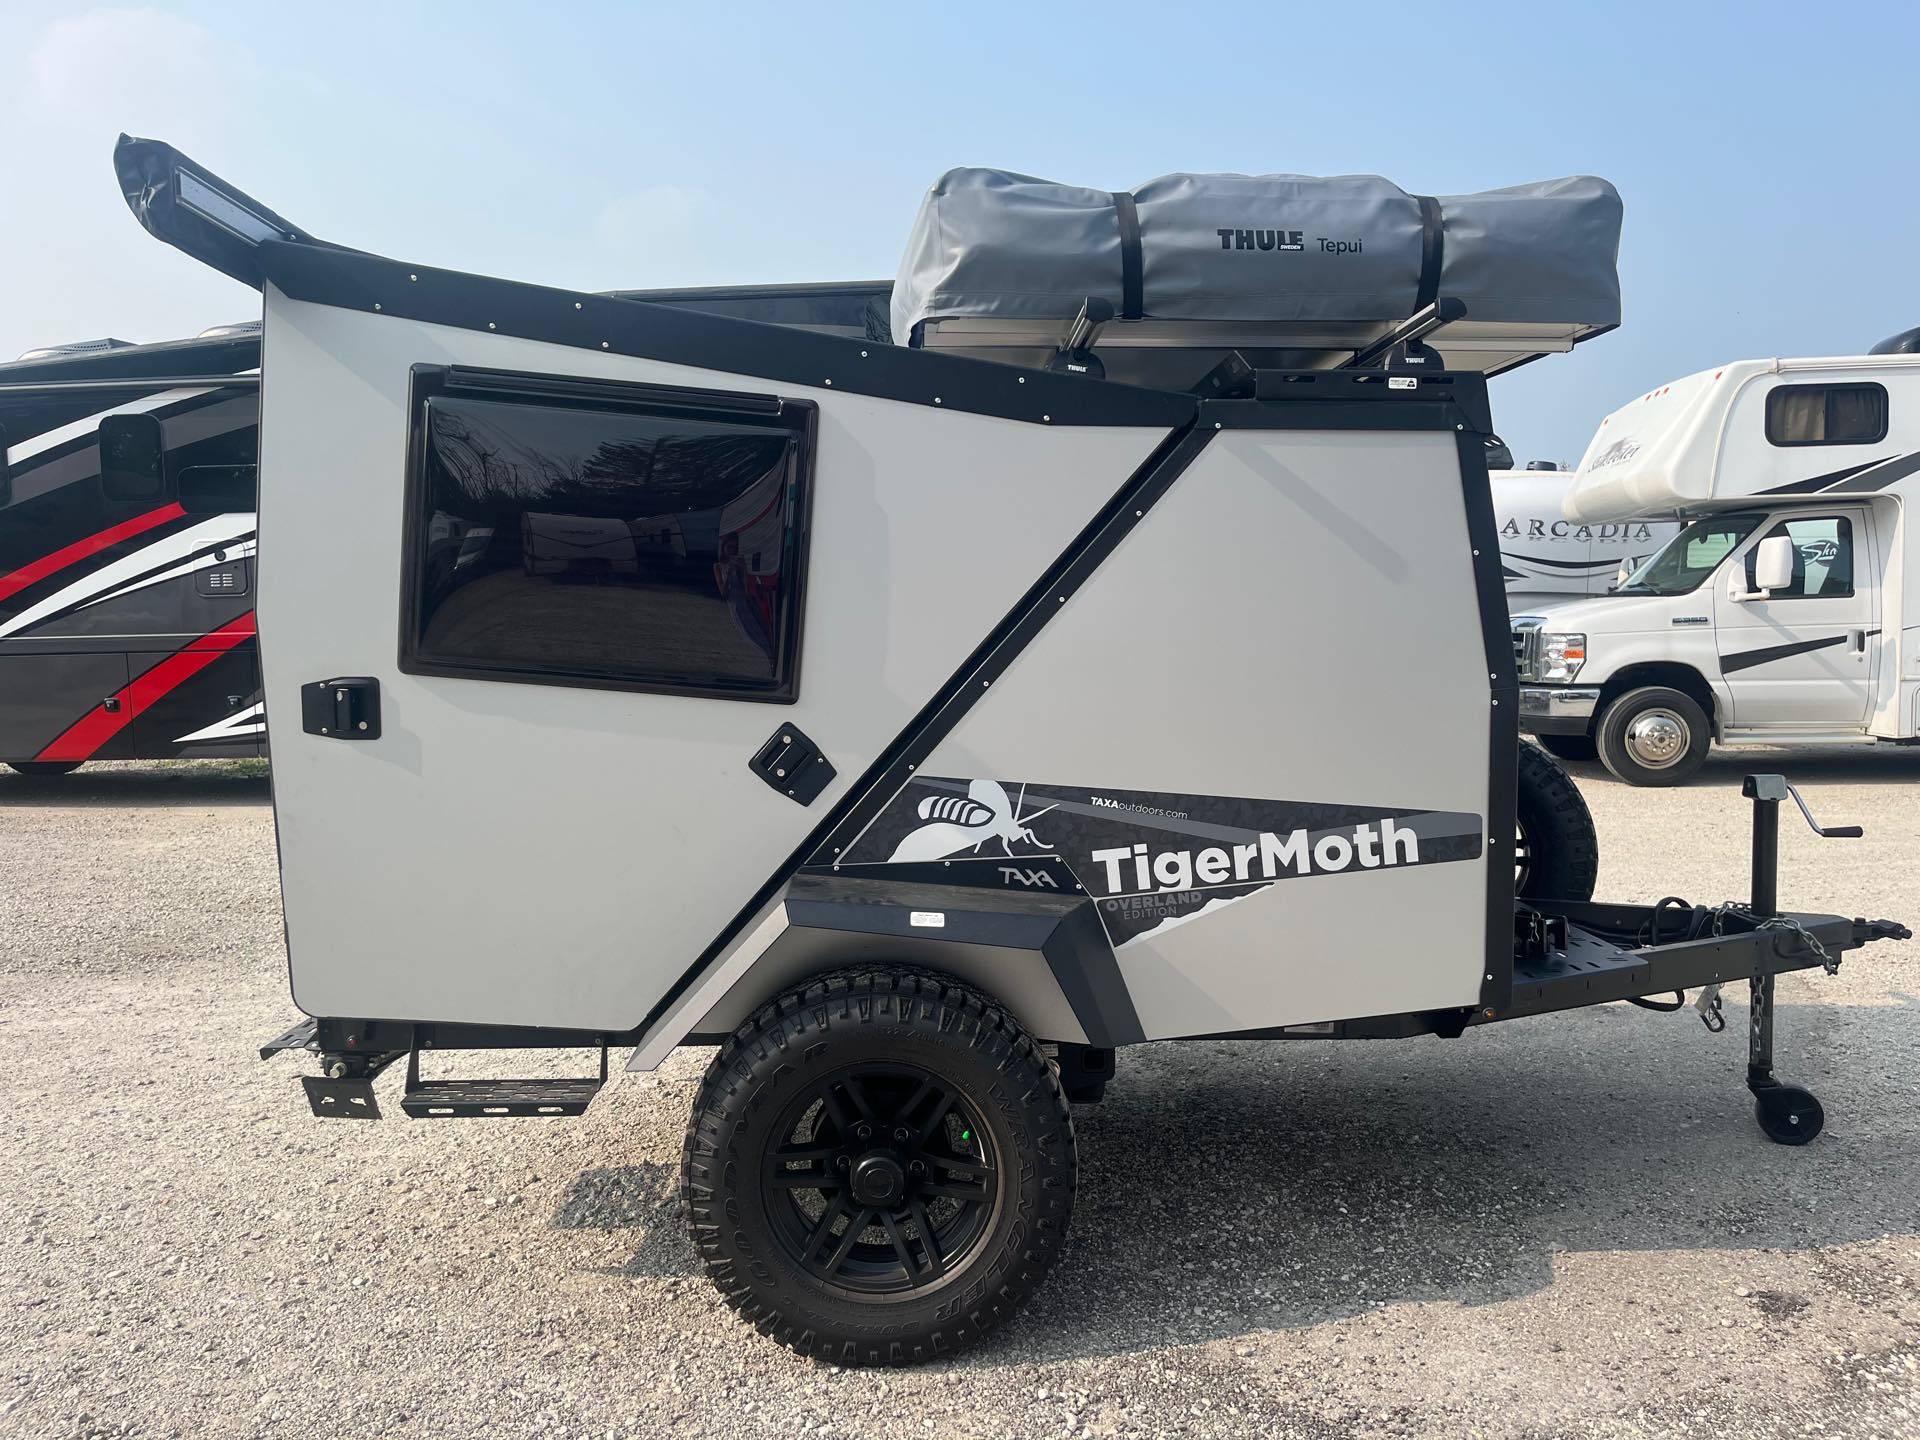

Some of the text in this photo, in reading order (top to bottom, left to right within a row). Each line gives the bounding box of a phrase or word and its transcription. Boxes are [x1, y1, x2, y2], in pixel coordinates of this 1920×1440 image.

[1217, 229, 1363, 255] THULE Tepui
[1067, 364, 1088, 373] THULE
[1500, 517, 1652, 539] ARCADIA
[1091, 796, 1188, 819] TAXAoutdoors.com
[1091, 818, 1419, 894] TigerMoth
[998, 866, 1059, 888] TAXA
[1105, 890, 1202, 912] OVERLAND
[1123, 905, 1177, 920] EDITION
